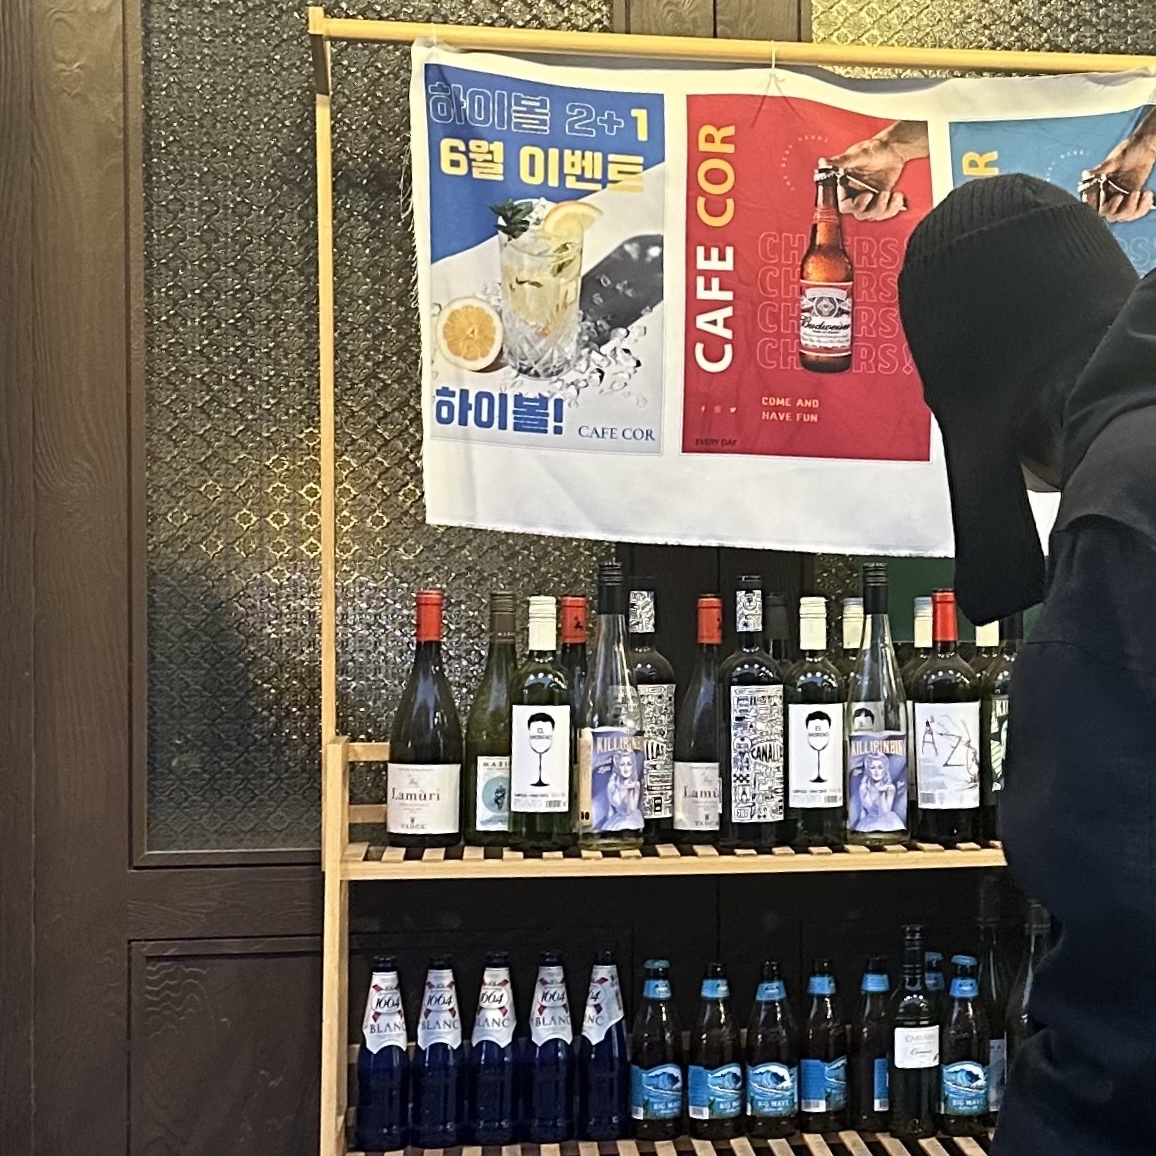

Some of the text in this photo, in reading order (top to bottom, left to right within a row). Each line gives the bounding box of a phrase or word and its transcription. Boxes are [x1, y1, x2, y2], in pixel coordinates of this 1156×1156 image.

[428, 81, 648, 142] 하이볼 2+1
[439, 136, 645, 193] 6월 이벤트
[694, 124, 736, 373] CAFE COR
[757, 231, 908, 269] CHRS
[757, 265, 899, 303] CHRS
[757, 301, 900, 339] CHRS
[756, 337, 914, 375] CHRS!
[435, 386, 563, 435] 하이볼!
[761, 396, 819, 408] COME AND
[761, 411, 818, 423] HAVE FUN
[578, 426, 656, 441] CAFE COR
[721, 438, 737, 447] DAY
[421, 1020, 459, 1030] BLANC
